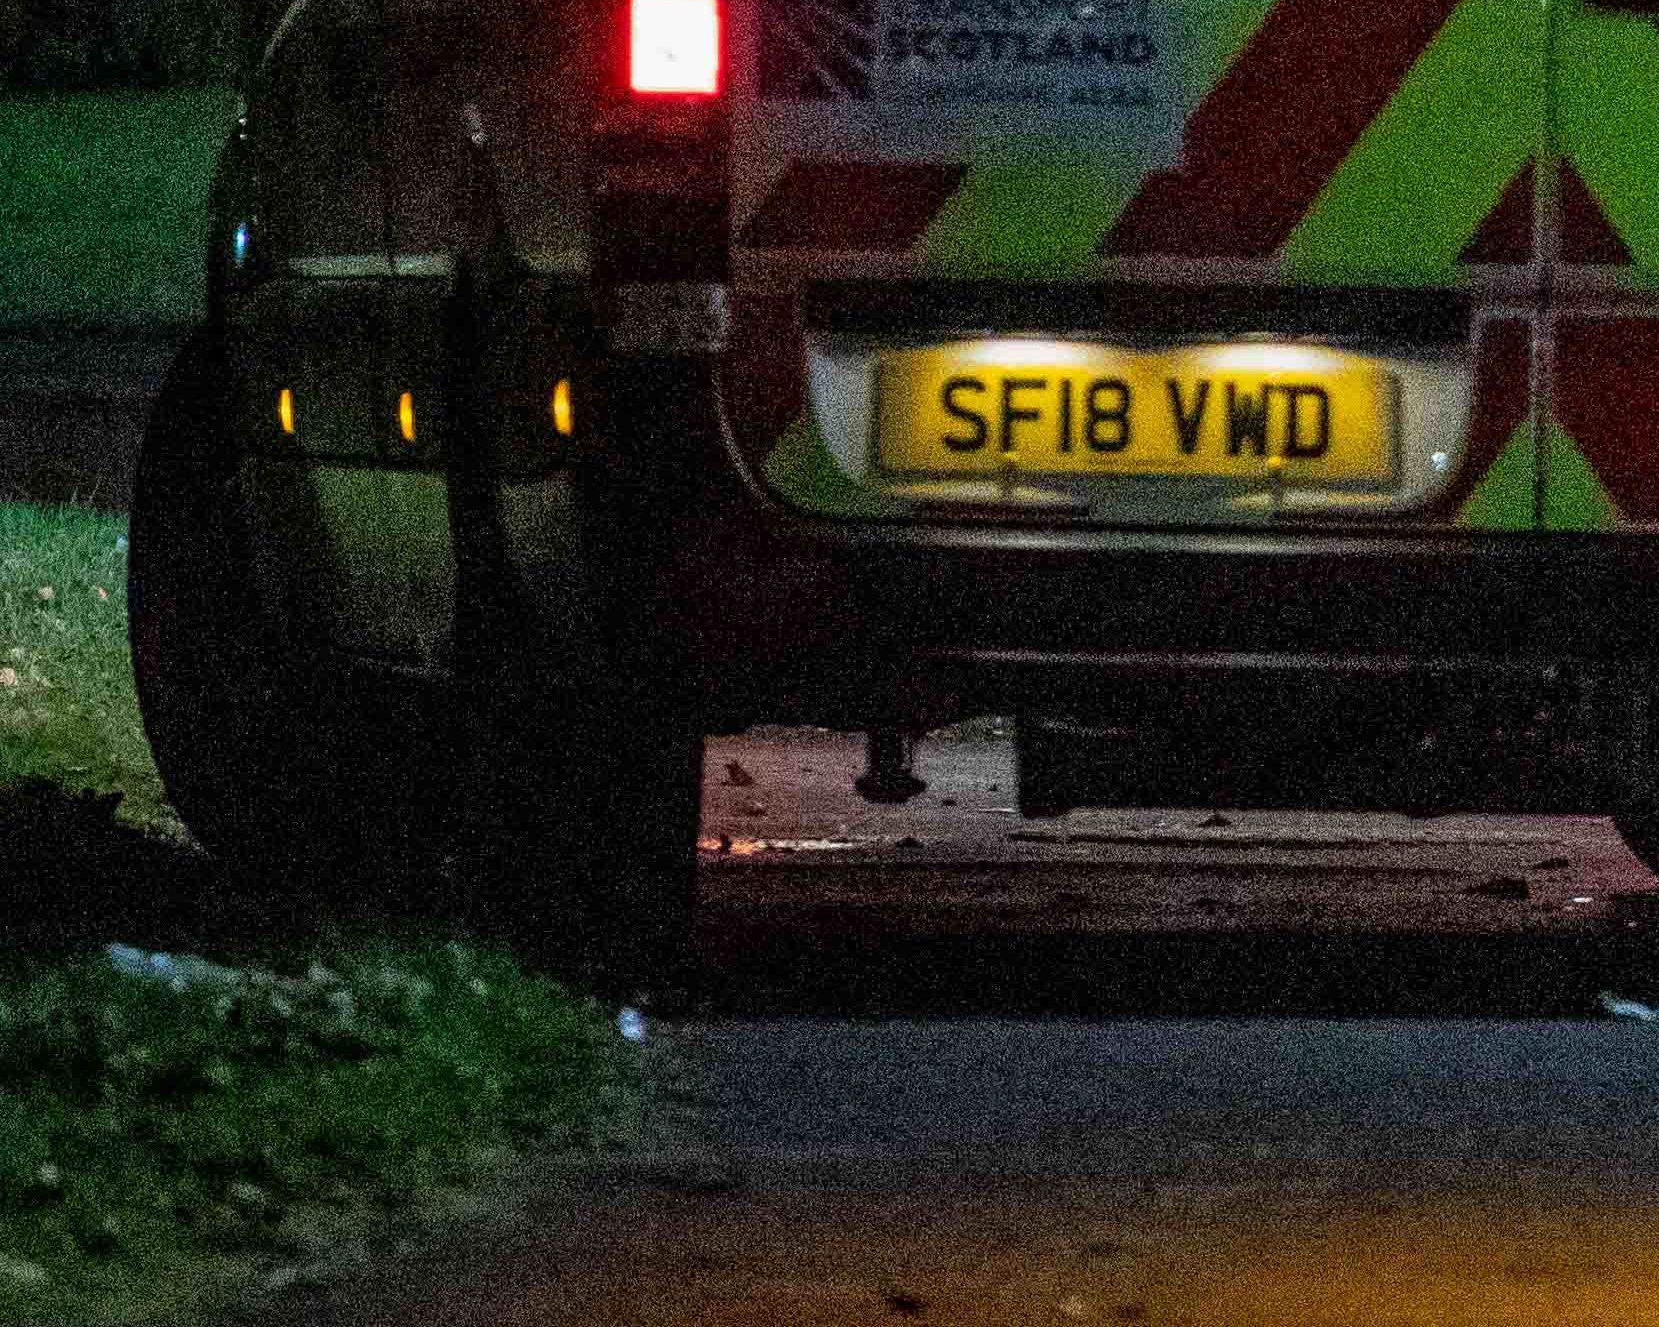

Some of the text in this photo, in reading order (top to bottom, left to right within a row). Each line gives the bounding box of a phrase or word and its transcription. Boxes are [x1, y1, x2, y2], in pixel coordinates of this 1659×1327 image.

[886, 27, 1157, 64] SCOTLAND
[940, 377, 1331, 458] SF18 VWD
